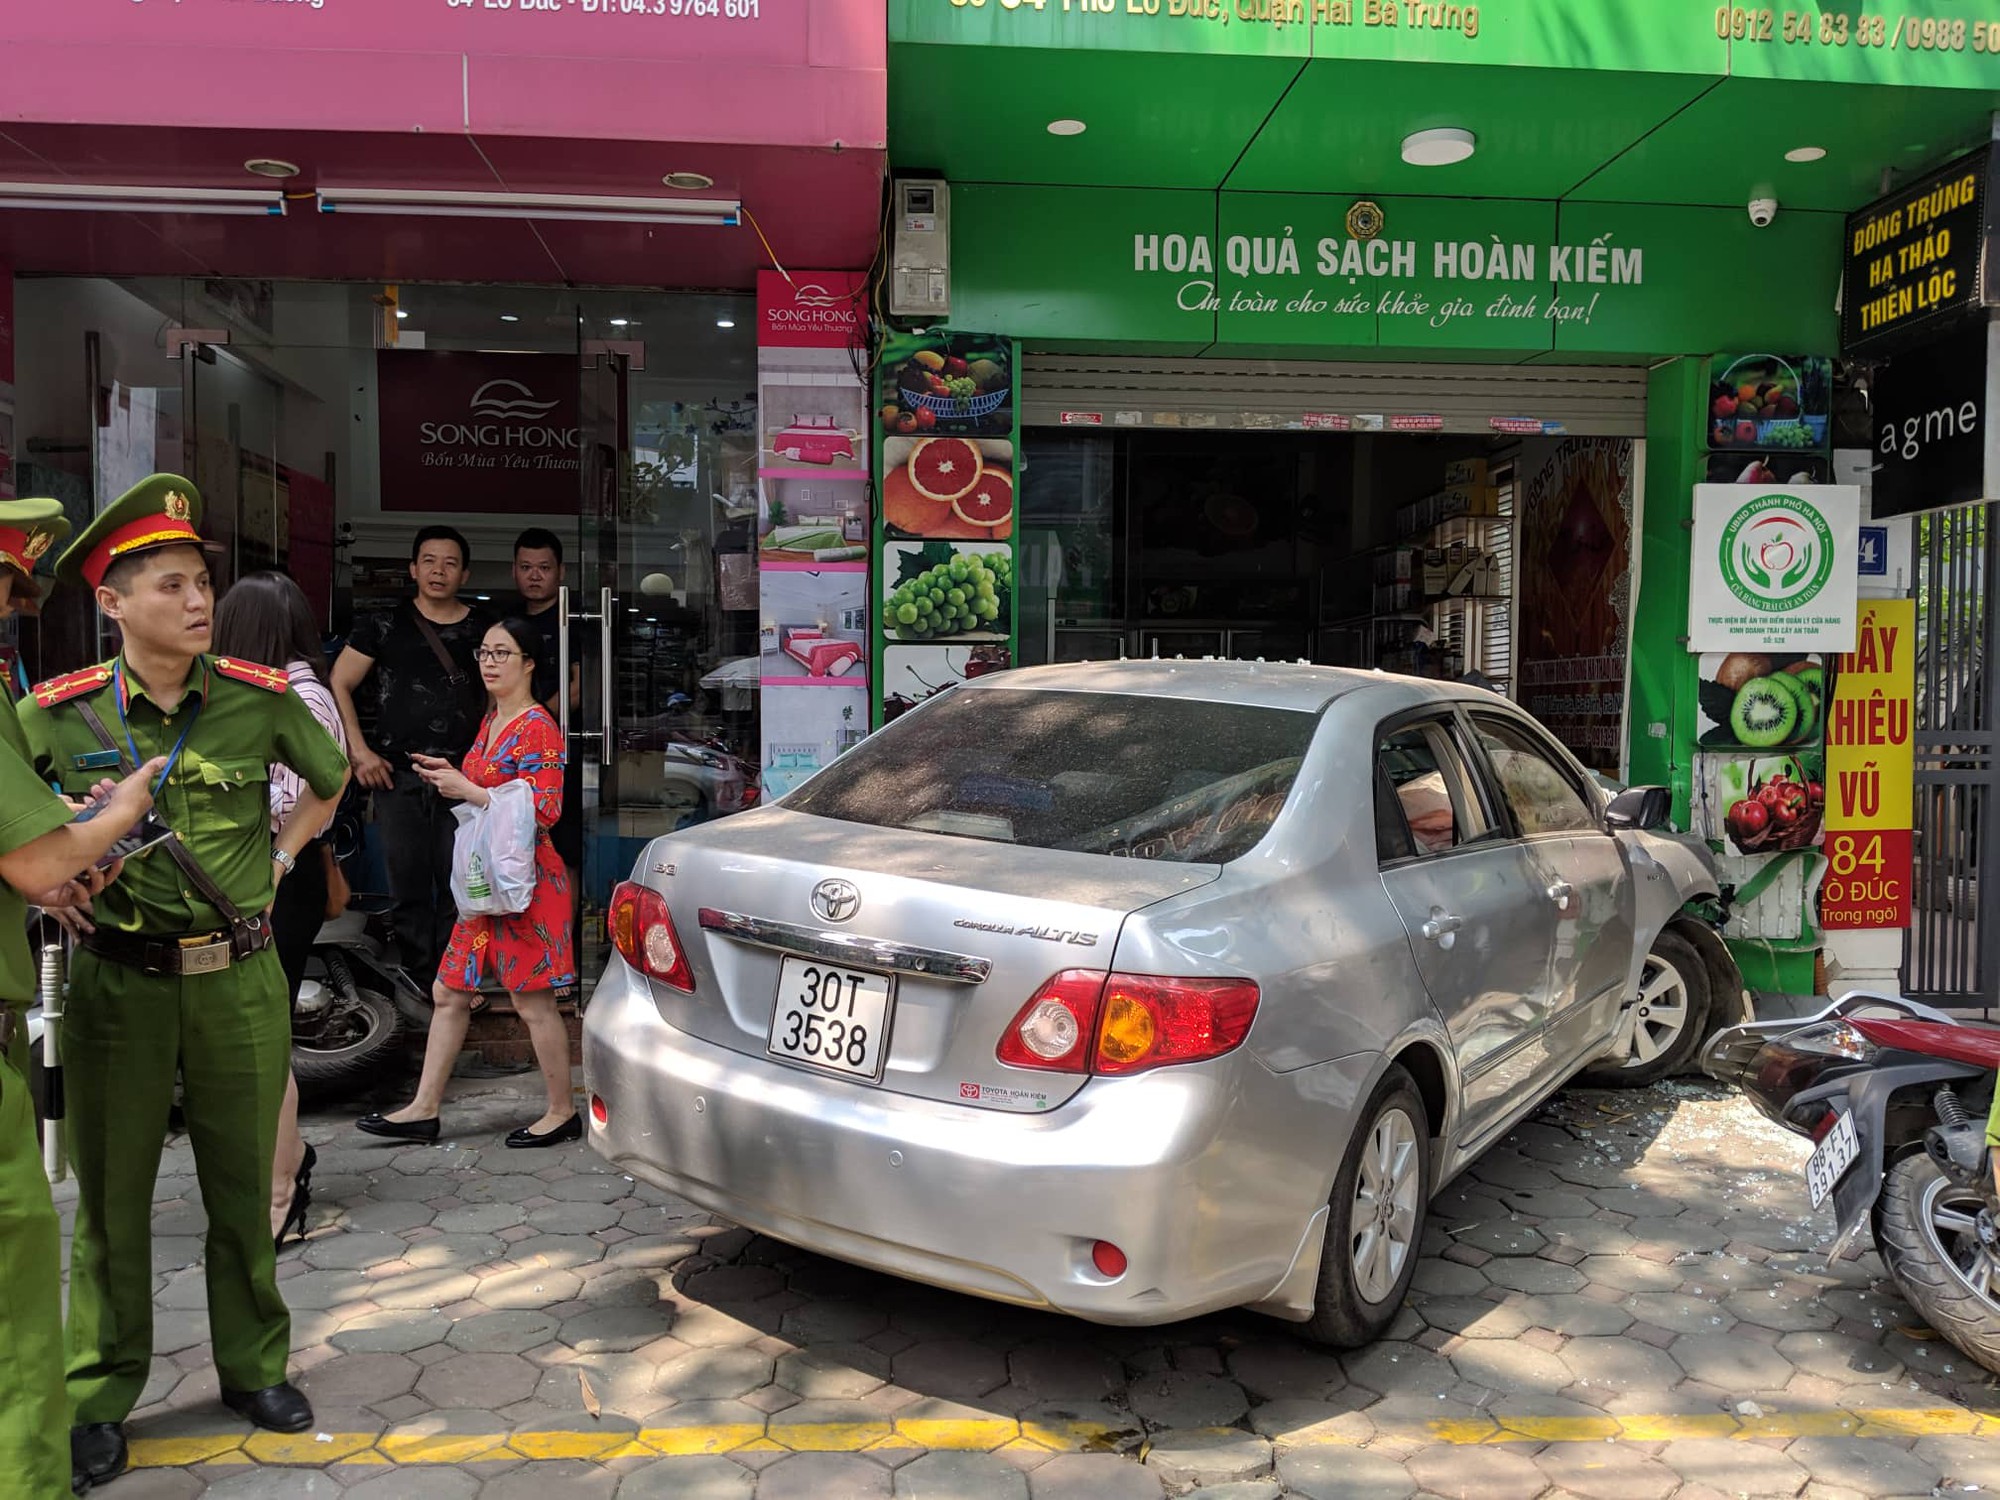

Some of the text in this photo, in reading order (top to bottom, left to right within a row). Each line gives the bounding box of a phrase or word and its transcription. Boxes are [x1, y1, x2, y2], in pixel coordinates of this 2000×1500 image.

[670, 0, 720, 17] 9764
[724, 0, 760, 18] 601
[1311, 0, 1353, 25] Hai
[1404, 0, 1479, 37] Trưng
[1715, 7, 1773, 42] 0912
[1782, 11, 1812, 43] 54
[1819, 13, 1850, 46] 83
[1856, 15, 1886, 47] 83
[1853, 209, 1902, 257] ĐÔNG
[1898, 222, 1951, 275] THẢO
[1133, 225, 1643, 285] HOA QUẢ SẠCH HOÀN KIẾM
[1177, 280, 1600, 328] An toàn cho sức khỏe gia đình bạn!
[1917, 266, 1957, 310] LỘC
[767, 308, 857, 323] SONG HONG
[419, 422, 500, 446] SONG
[1880, 400, 1977, 460] agme
[421, 451, 581, 470] Bốn Mùa Yêu Thươn
[1729, 510, 1749, 533] UBND
[1749, 498, 1780, 512] THÀNH
[1825, 688, 1909, 746] HIÊU
[1839, 761, 1880, 818] VŨ
[1831, 834, 1886, 875] 84
[1822, 876, 1899, 902] Ò ĐÚC
[1866, 905, 1897, 924] ngõ)
[1014, 925, 1099, 947] ALTIS
[799, 966, 866, 1018] 30T
[782, 1009, 868, 1067] 3538
[982, 1086, 1008, 1096] TOYOTA
